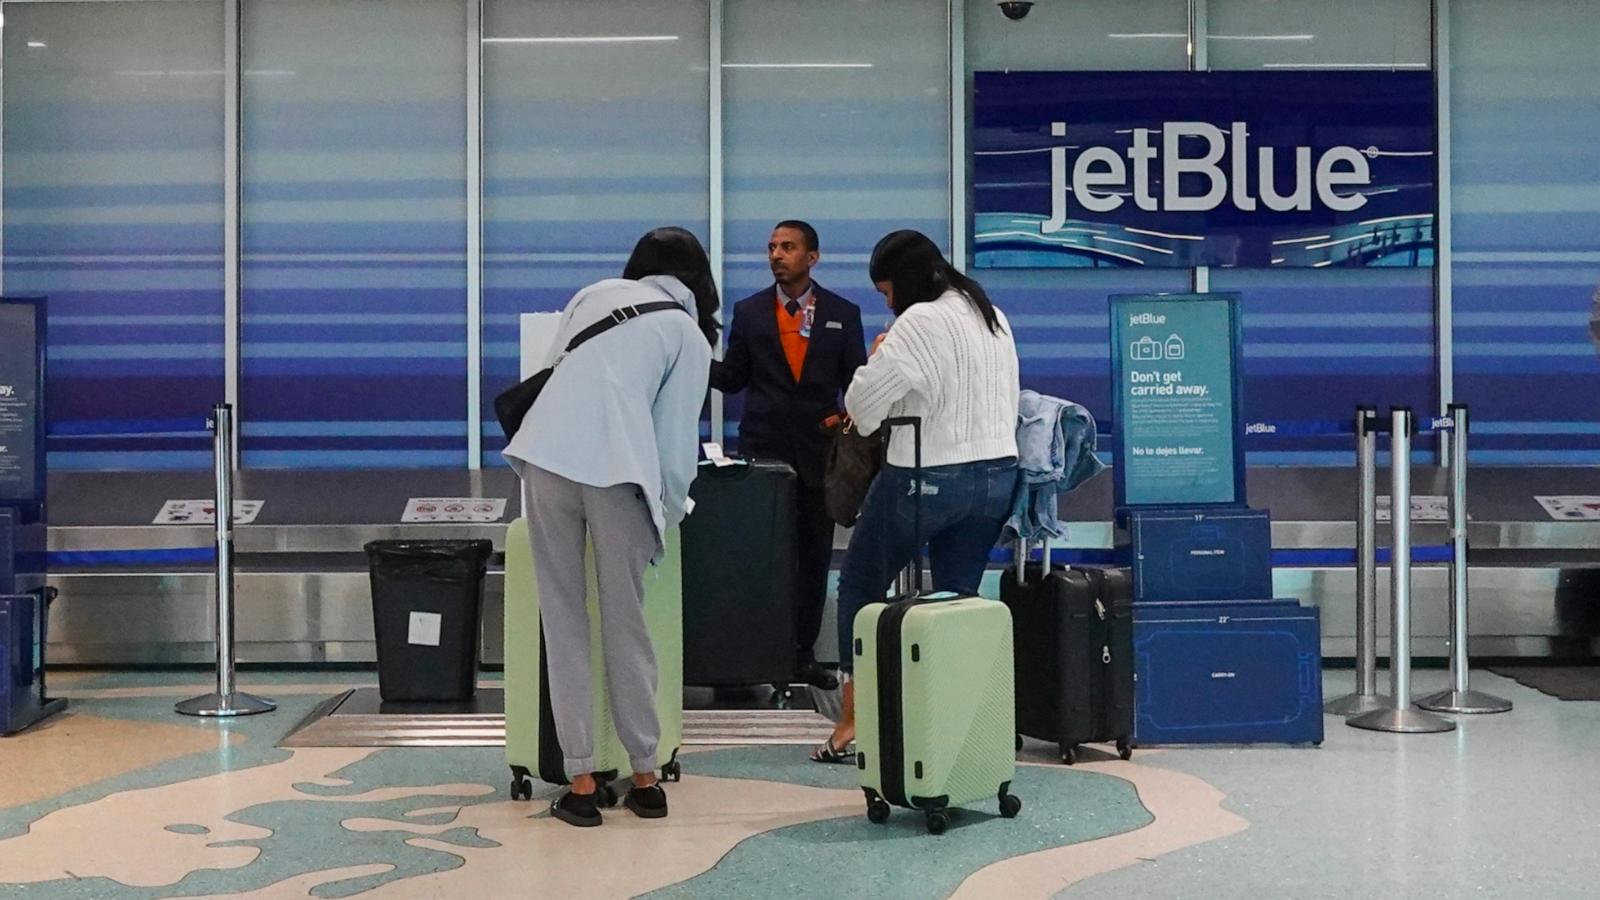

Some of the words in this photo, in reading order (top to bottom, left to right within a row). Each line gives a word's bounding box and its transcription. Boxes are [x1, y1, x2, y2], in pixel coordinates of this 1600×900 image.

[1129, 313, 1166, 327] jetBlue
[1131, 371, 1160, 383] Don't
[1163, 371, 1182, 385] get
[0, 385, 15, 397] ay.
[1131, 384, 1173, 395] carried
[1176, 385, 1209, 397] away.
[1245, 423, 1276, 435] jetBlue
[1132, 446, 1145, 456] No
[1146, 446, 1155, 455] te
[1156, 446, 1177, 457] dejes
[1178, 445, 1205, 456] llevar.
